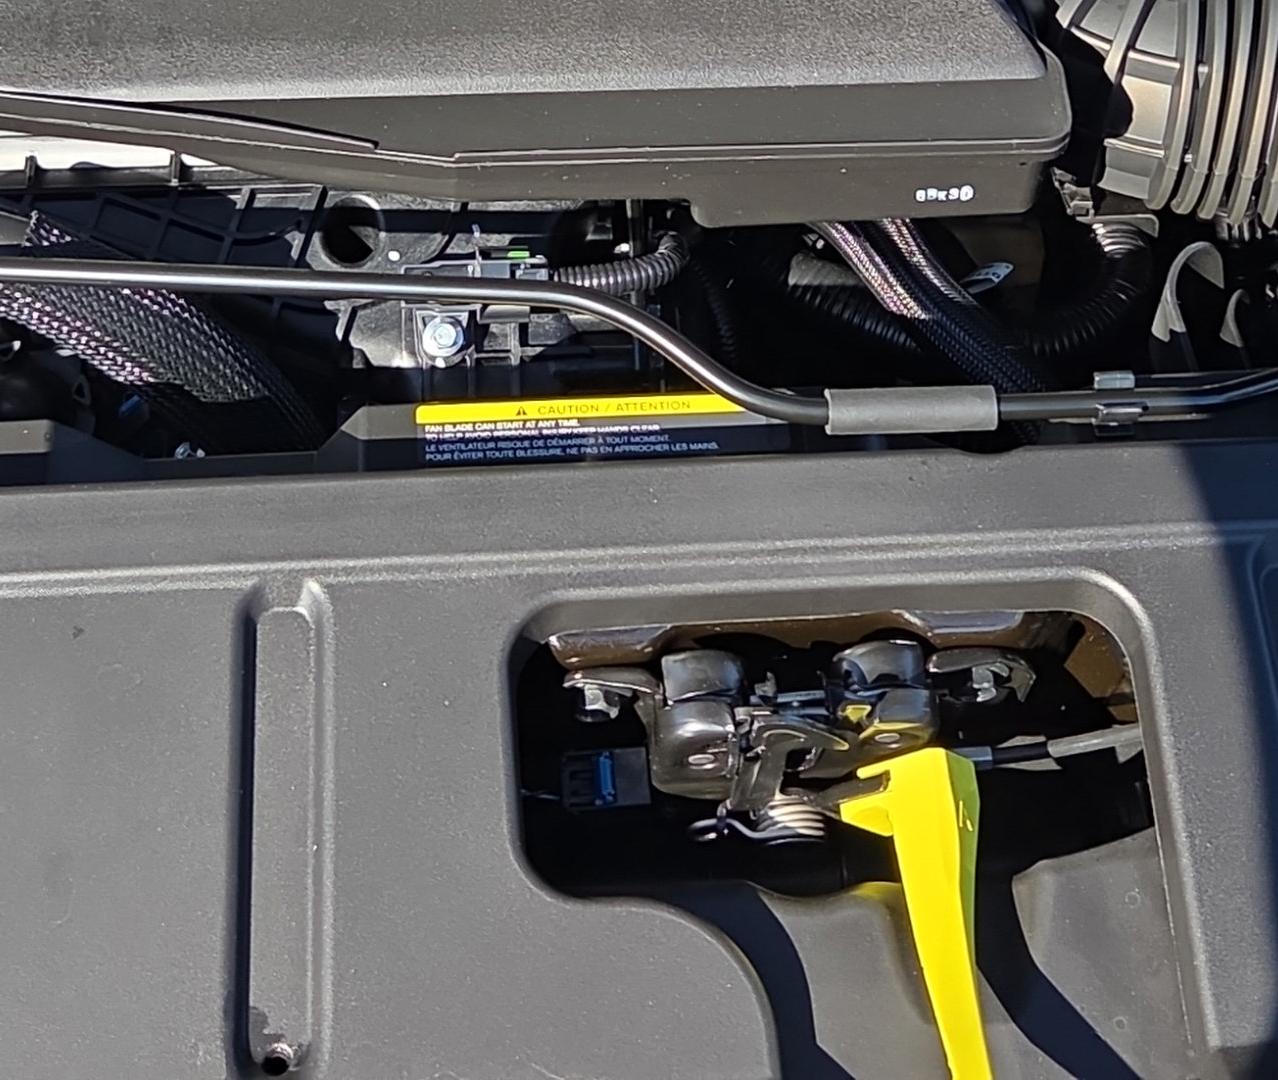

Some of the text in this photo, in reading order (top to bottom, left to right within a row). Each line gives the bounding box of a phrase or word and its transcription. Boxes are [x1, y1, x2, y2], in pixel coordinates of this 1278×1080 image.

[537, 404, 600, 416] CAUTION
[616, 400, 691, 412] ATTENTION
[424, 424, 443, 433] FAN
[443, 423, 474, 432] BLADE
[475, 422, 495, 431] CAN
[496, 421, 524, 430] START
[525, 420, 537, 429] AT
[537, 419, 556, 428] ANY
[425, 444, 437, 453] LE
[437, 440, 496, 452] VENTILATEUR
[532, 438, 545, 448] DE
[606, 435, 628, 445] TOUT
[425, 452, 452, 461] POUR
[485, 450, 515, 459] TOUTE
[580, 445, 599, 455] PAS
[599, 444, 613, 453] EN
[671, 442, 688, 452] LES
